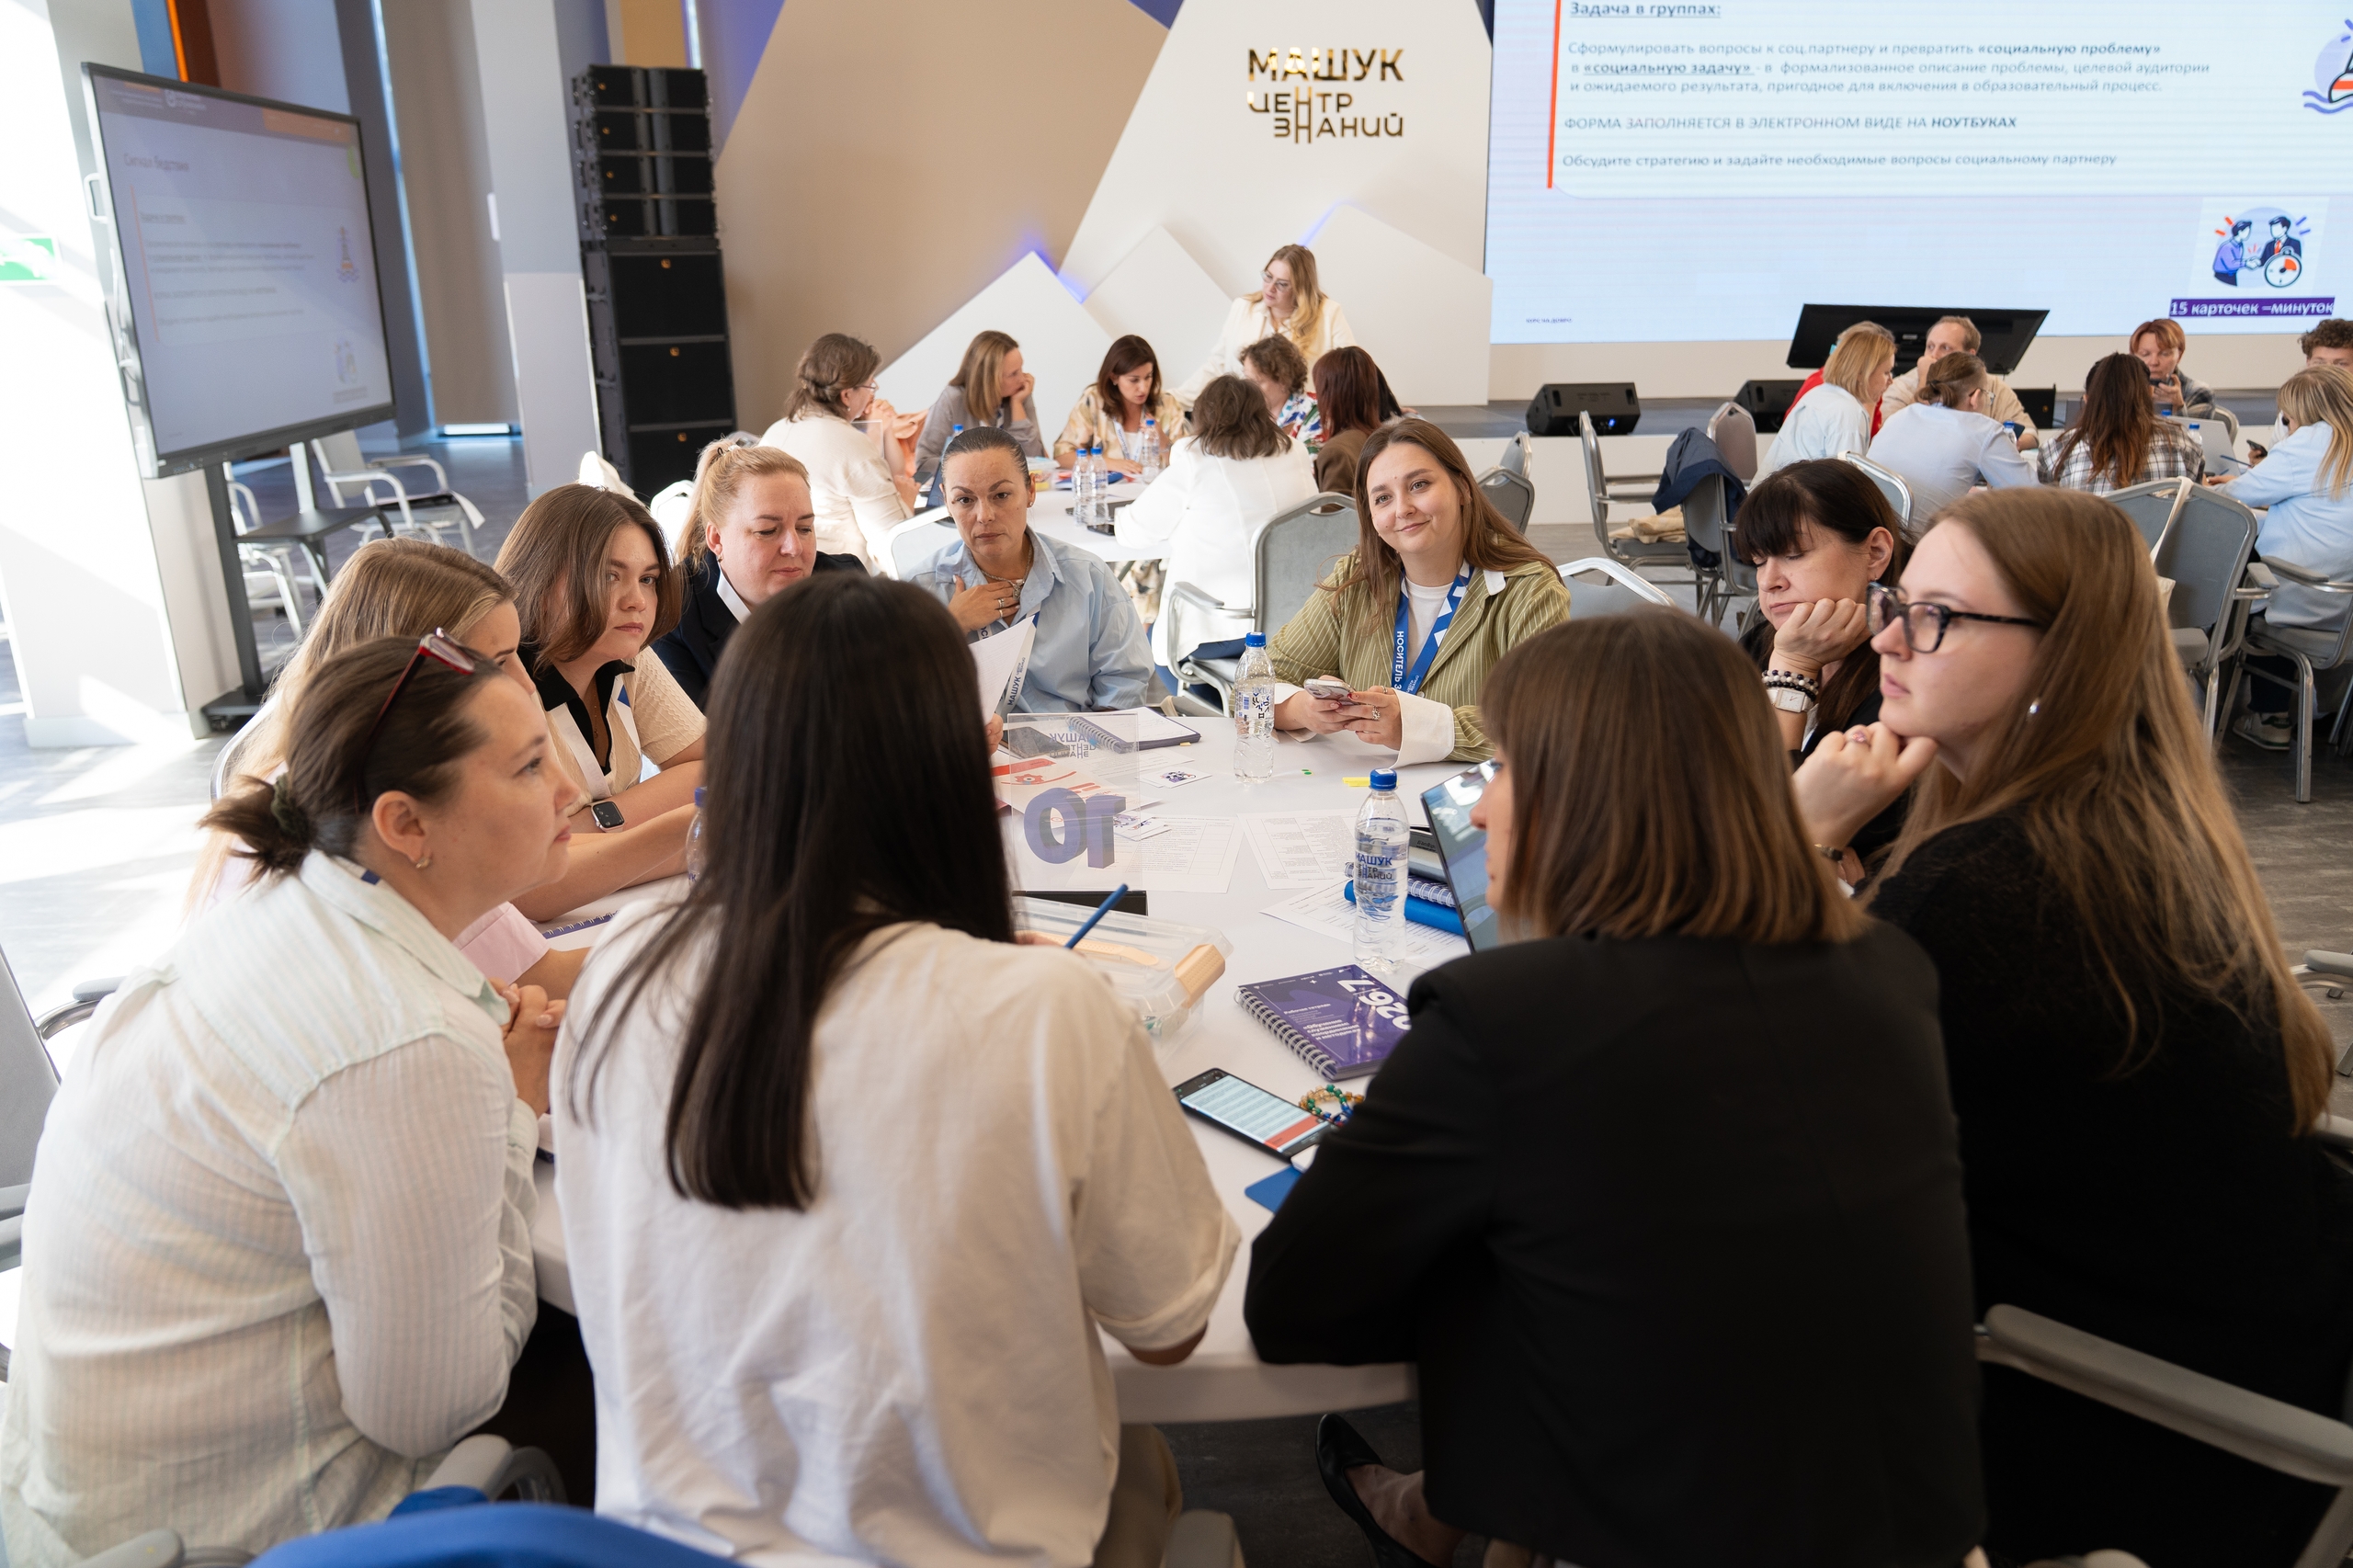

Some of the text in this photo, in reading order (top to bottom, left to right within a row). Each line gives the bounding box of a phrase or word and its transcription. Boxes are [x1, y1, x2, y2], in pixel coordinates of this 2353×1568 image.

[1570, 2, 1721, 17] Задача в группах:
[1568, 42, 2160, 56] Сформулировать вопросы к соц.партнеру и превратить «социальную проблему»
[1248, 46, 1404, 81] МАШУК
[1571, 63, 1579, 73] в
[1584, 63, 1687, 74] «социальную
[1691, 63, 1750, 74] задачу»
[1765, 63, 1772, 73] в
[1780, 62, 1914, 74] формализованное
[1919, 63, 1986, 74] описание
[1992, 62, 2067, 74] проблемы,
[2074, 62, 2131, 74] целевой
[2136, 62, 2210, 74] аудитории
[1570, 80, 2162, 93] и ожидаемого результата, пригодное для включения в образовательный процесс.
[1246, 86, 1353, 113] ЦЕНТР
[1274, 112, 1404, 143] ЗНАНИЙ
[1564, 117, 2017, 130] ФОРМА ЗАПОЛНЯЕТСЯ В ЭЛЕКТРОННОМ ВИДЕ НА НОУТБУКАХ
[1563, 154, 2117, 167] Обсудите стратегию и задайте необходимые вопросы социальному партнеру
[2170, 301, 2188, 315] 15
[2191, 302, 2258, 317] карточек
[1394, 631, 1404, 682] НОСИТЕЛЬ
[1007, 676, 1021, 705] МАШУК
